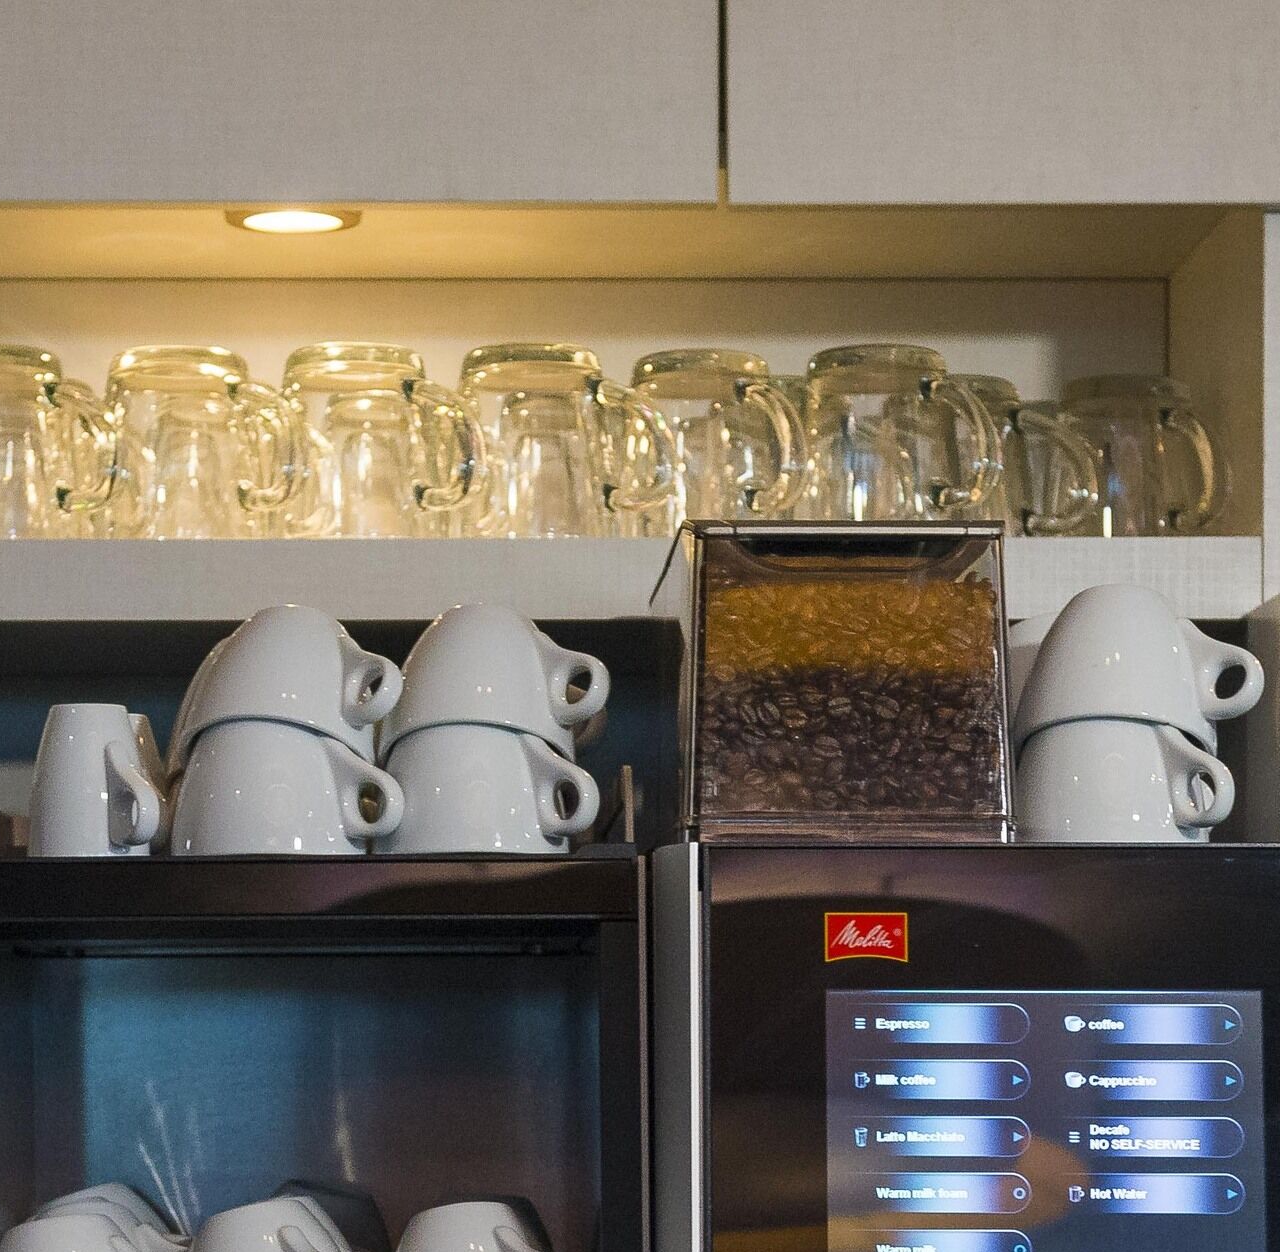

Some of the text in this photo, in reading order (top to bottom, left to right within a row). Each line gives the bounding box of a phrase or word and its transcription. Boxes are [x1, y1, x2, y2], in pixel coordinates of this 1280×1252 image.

[830, 919, 895, 949] Melitta
[876, 1019, 930, 1030] Espresso
[1089, 1019, 1124, 1030] coffee
[901, 1074, 936, 1086] coffee
[1089, 1074, 1157, 1088] Cappuccino
[877, 1131, 965, 1143] Latte Macchiato
[1090, 1139, 1200, 1150] NO SELF-SERVICE
[876, 1188, 967, 1199] Warm milk foam
[1090, 1188, 1147, 1200] Hot Water
